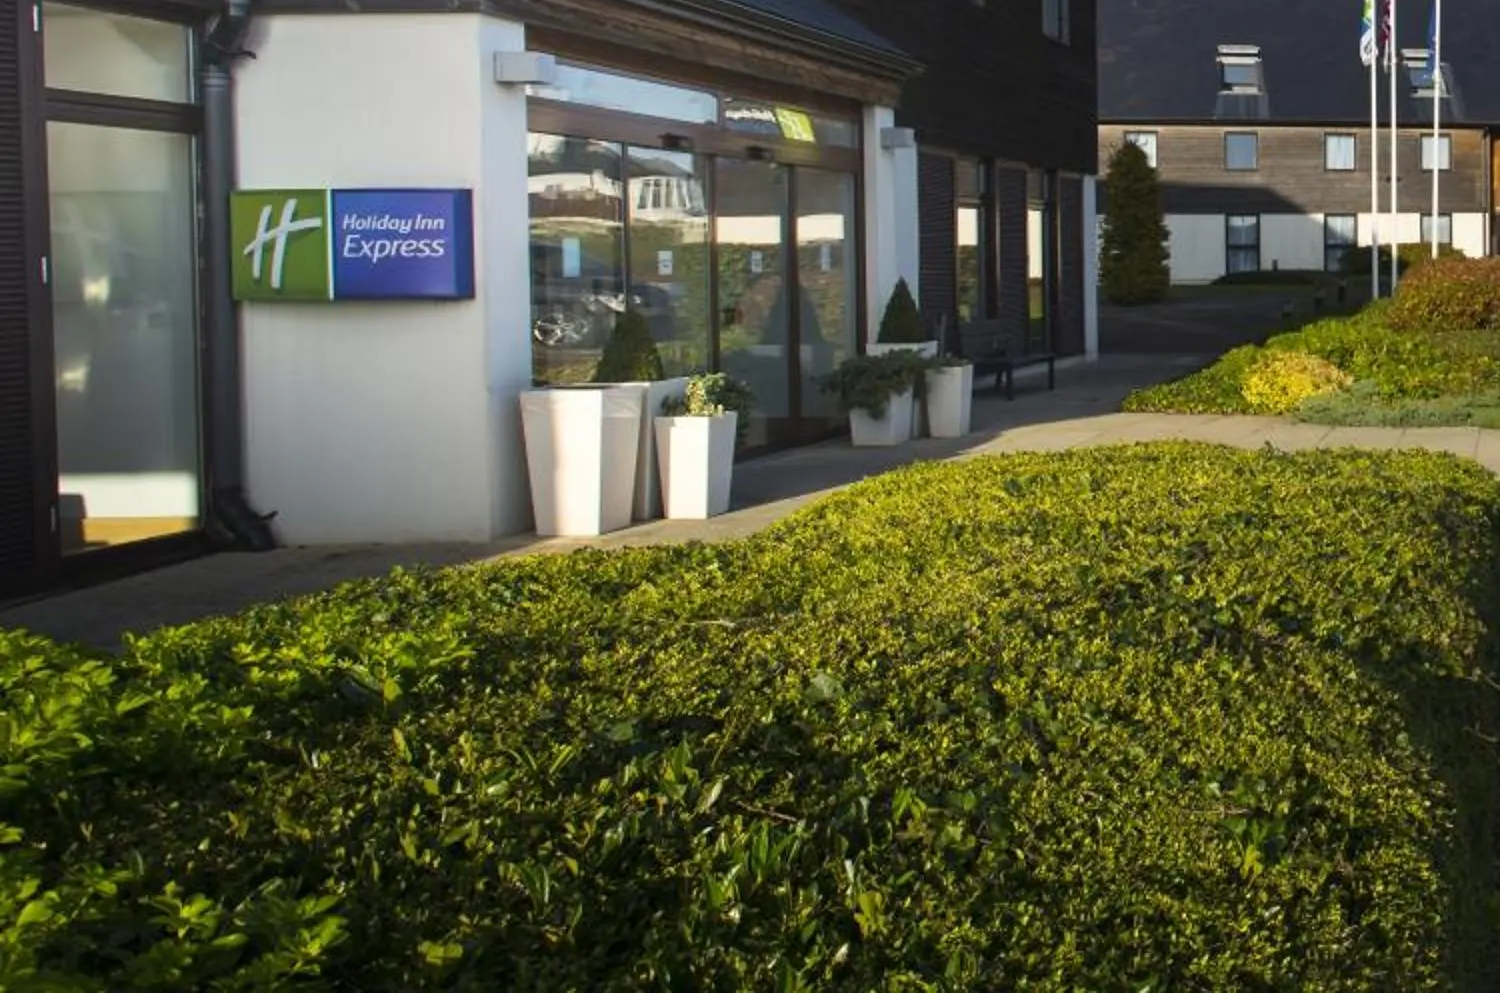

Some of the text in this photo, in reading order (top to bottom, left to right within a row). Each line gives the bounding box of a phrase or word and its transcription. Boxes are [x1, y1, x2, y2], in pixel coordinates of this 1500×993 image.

[342, 213, 445, 234] Holiday Inn
[342, 234, 445, 264] Express
